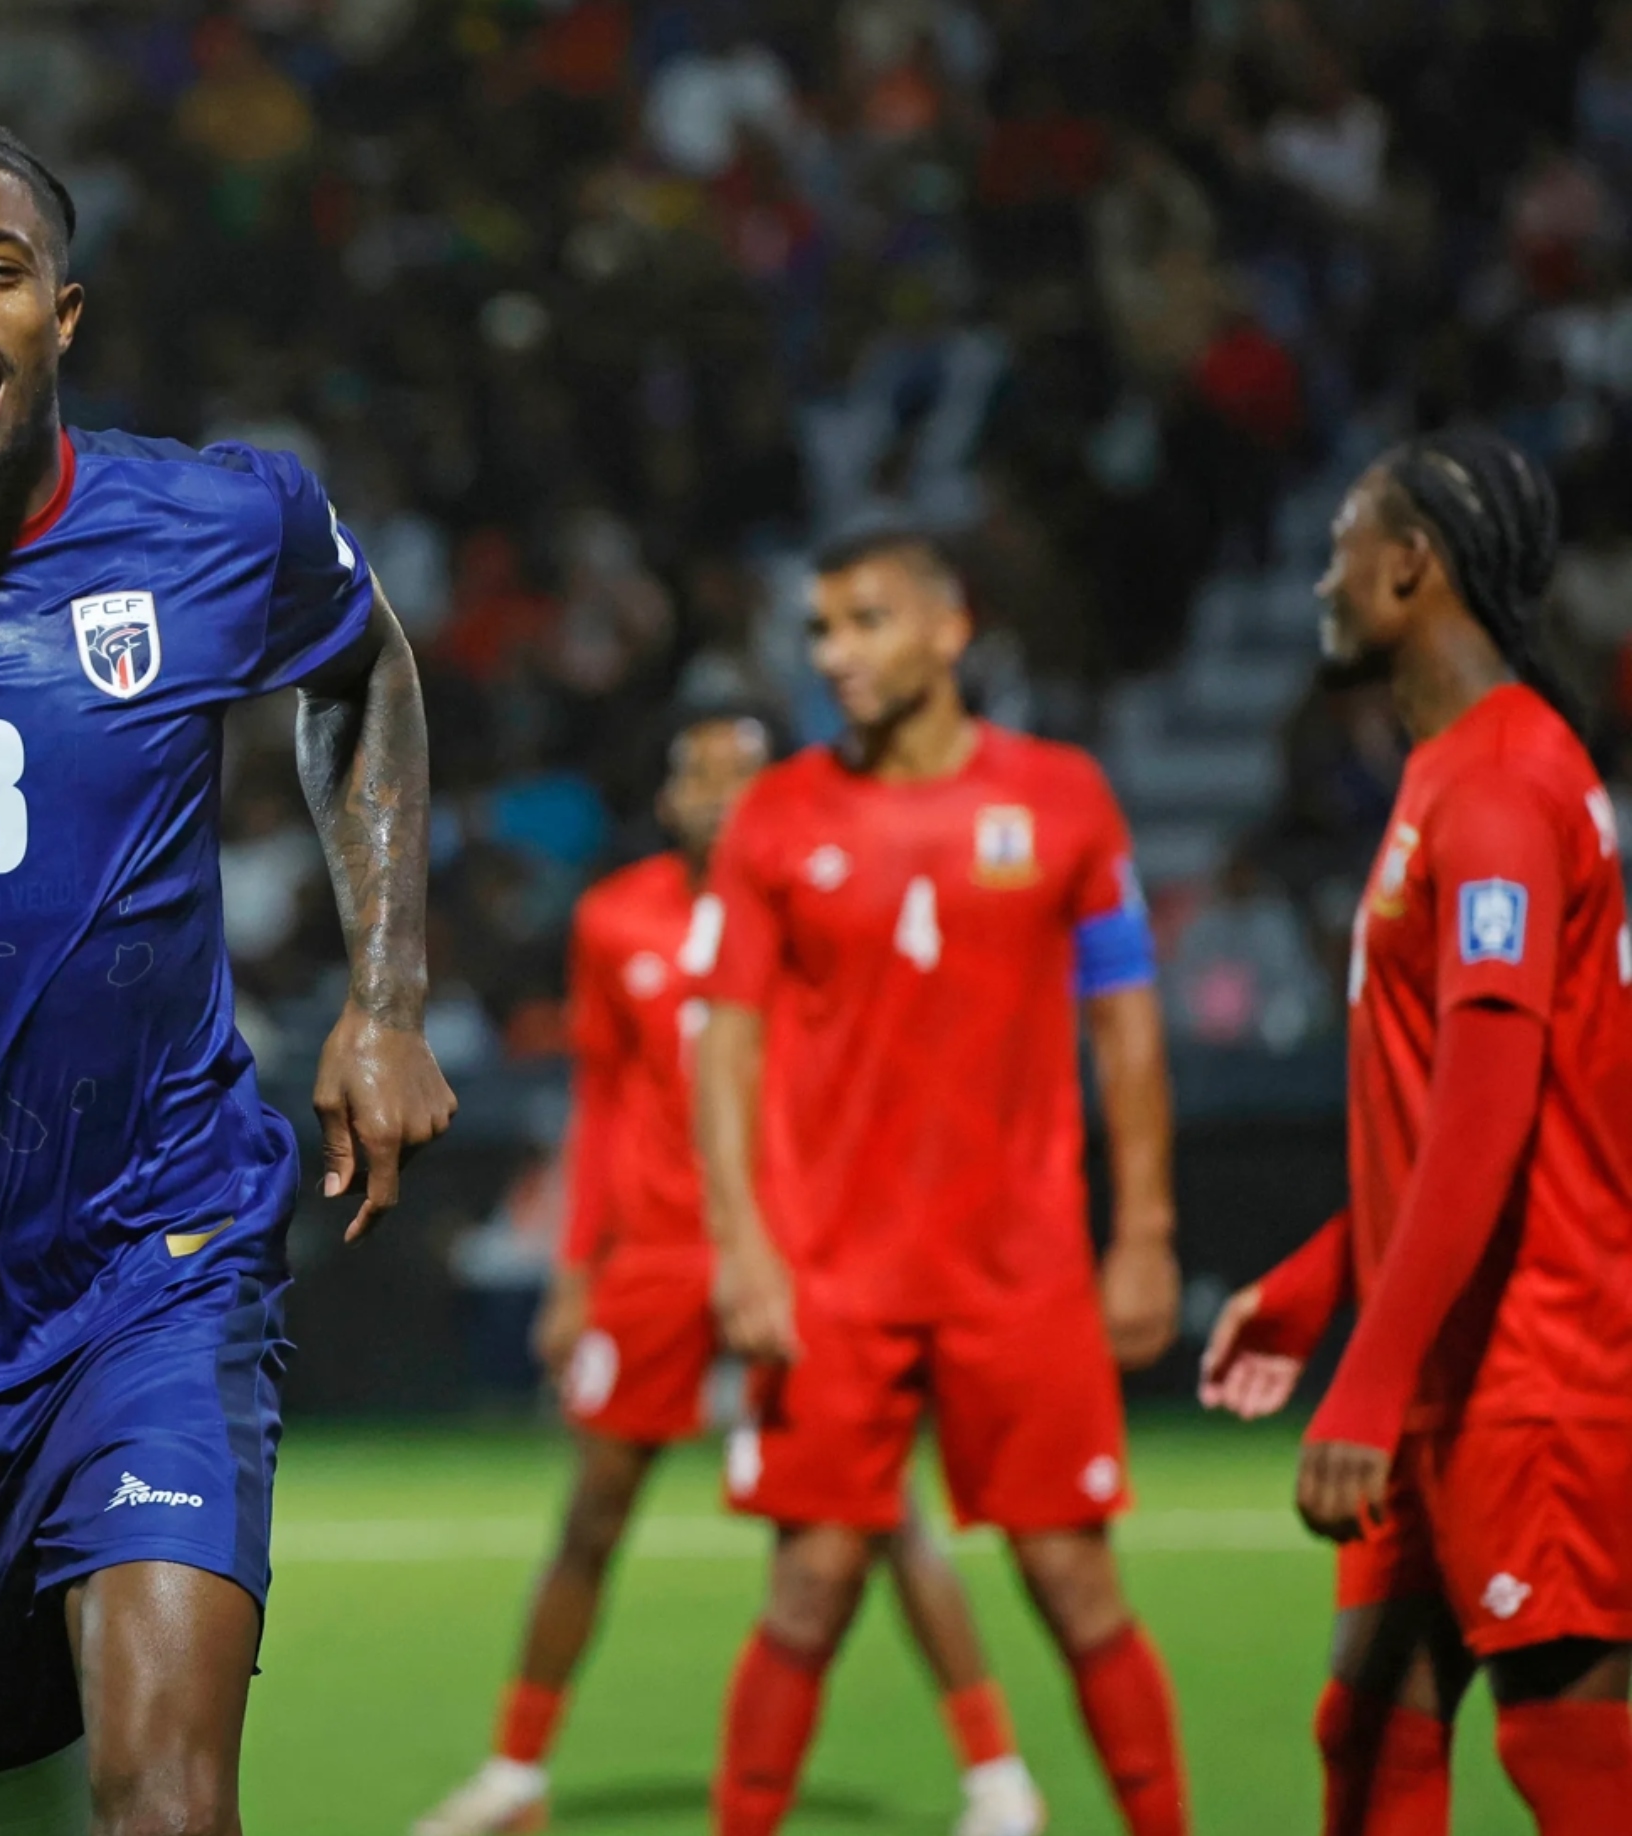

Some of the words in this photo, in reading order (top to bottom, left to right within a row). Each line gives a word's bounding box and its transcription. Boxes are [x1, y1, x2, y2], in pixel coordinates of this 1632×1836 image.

[80, 599, 143, 620] FCF
[893, 873, 944, 973] 4
[129, 1491, 203, 1508] tempo
